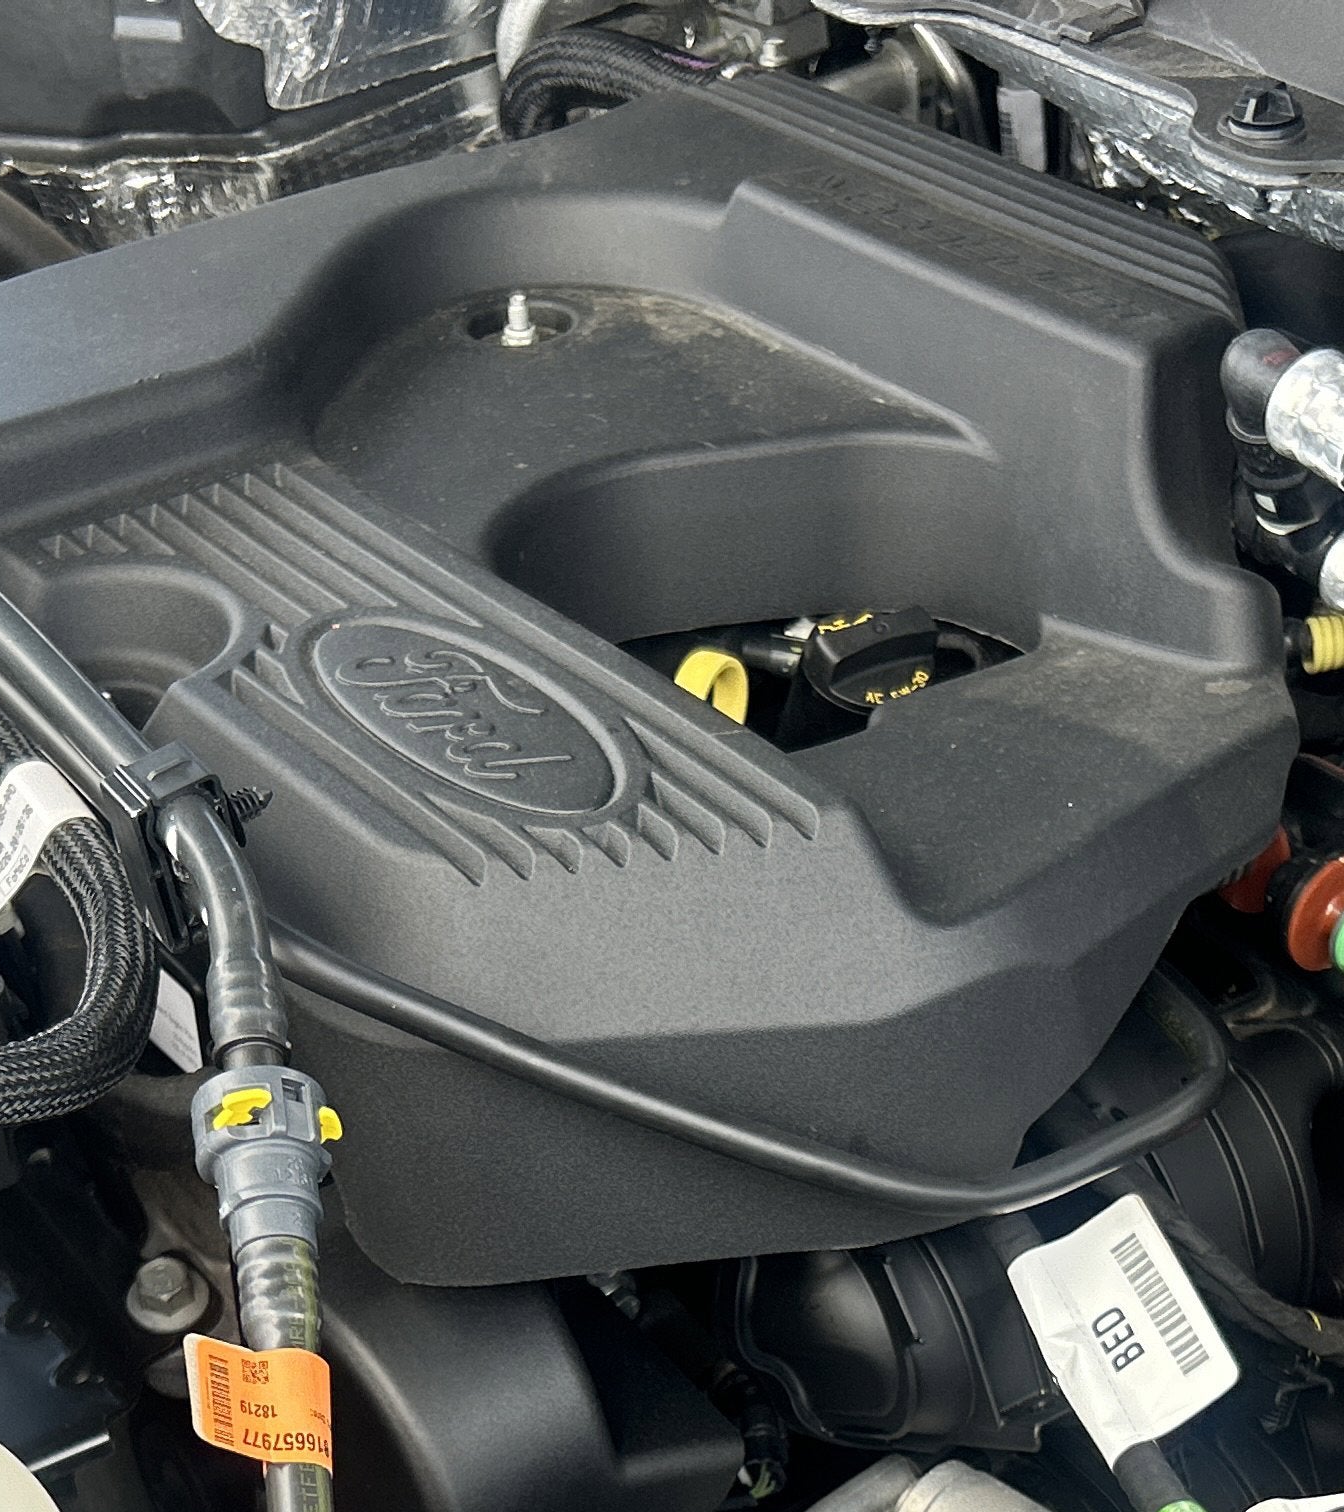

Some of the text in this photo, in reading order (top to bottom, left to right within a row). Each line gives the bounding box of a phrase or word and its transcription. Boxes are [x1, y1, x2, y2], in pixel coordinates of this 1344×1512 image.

[334, 649, 573, 781] Ford
[1087, 1303, 1147, 1374] BED
[239, 1399, 278, 1417] 18219
